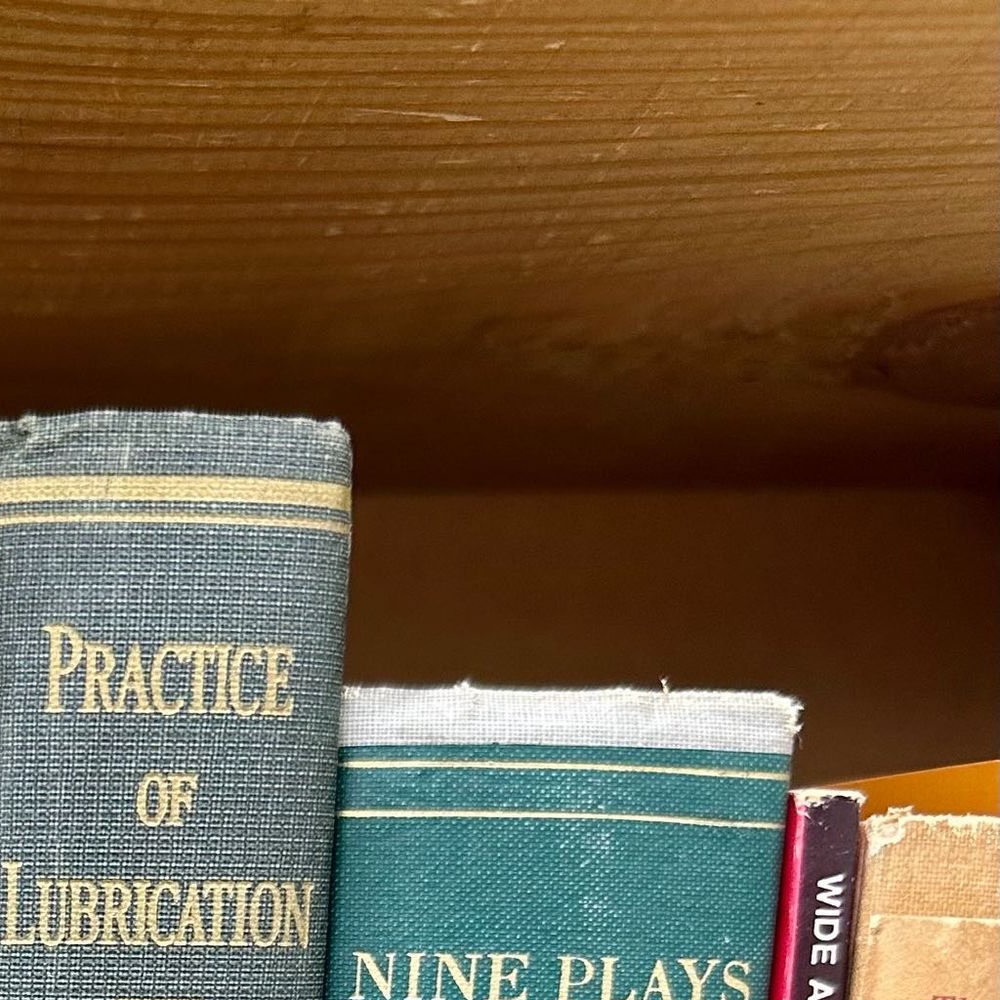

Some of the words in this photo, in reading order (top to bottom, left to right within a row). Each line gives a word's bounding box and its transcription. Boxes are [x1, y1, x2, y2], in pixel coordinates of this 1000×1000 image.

[43, 623, 295, 717] PRACTICE
[136, 772, 197, 828] OF
[1, 861, 313, 949] LUBRICATION
[811, 874, 846, 967] WIDE
